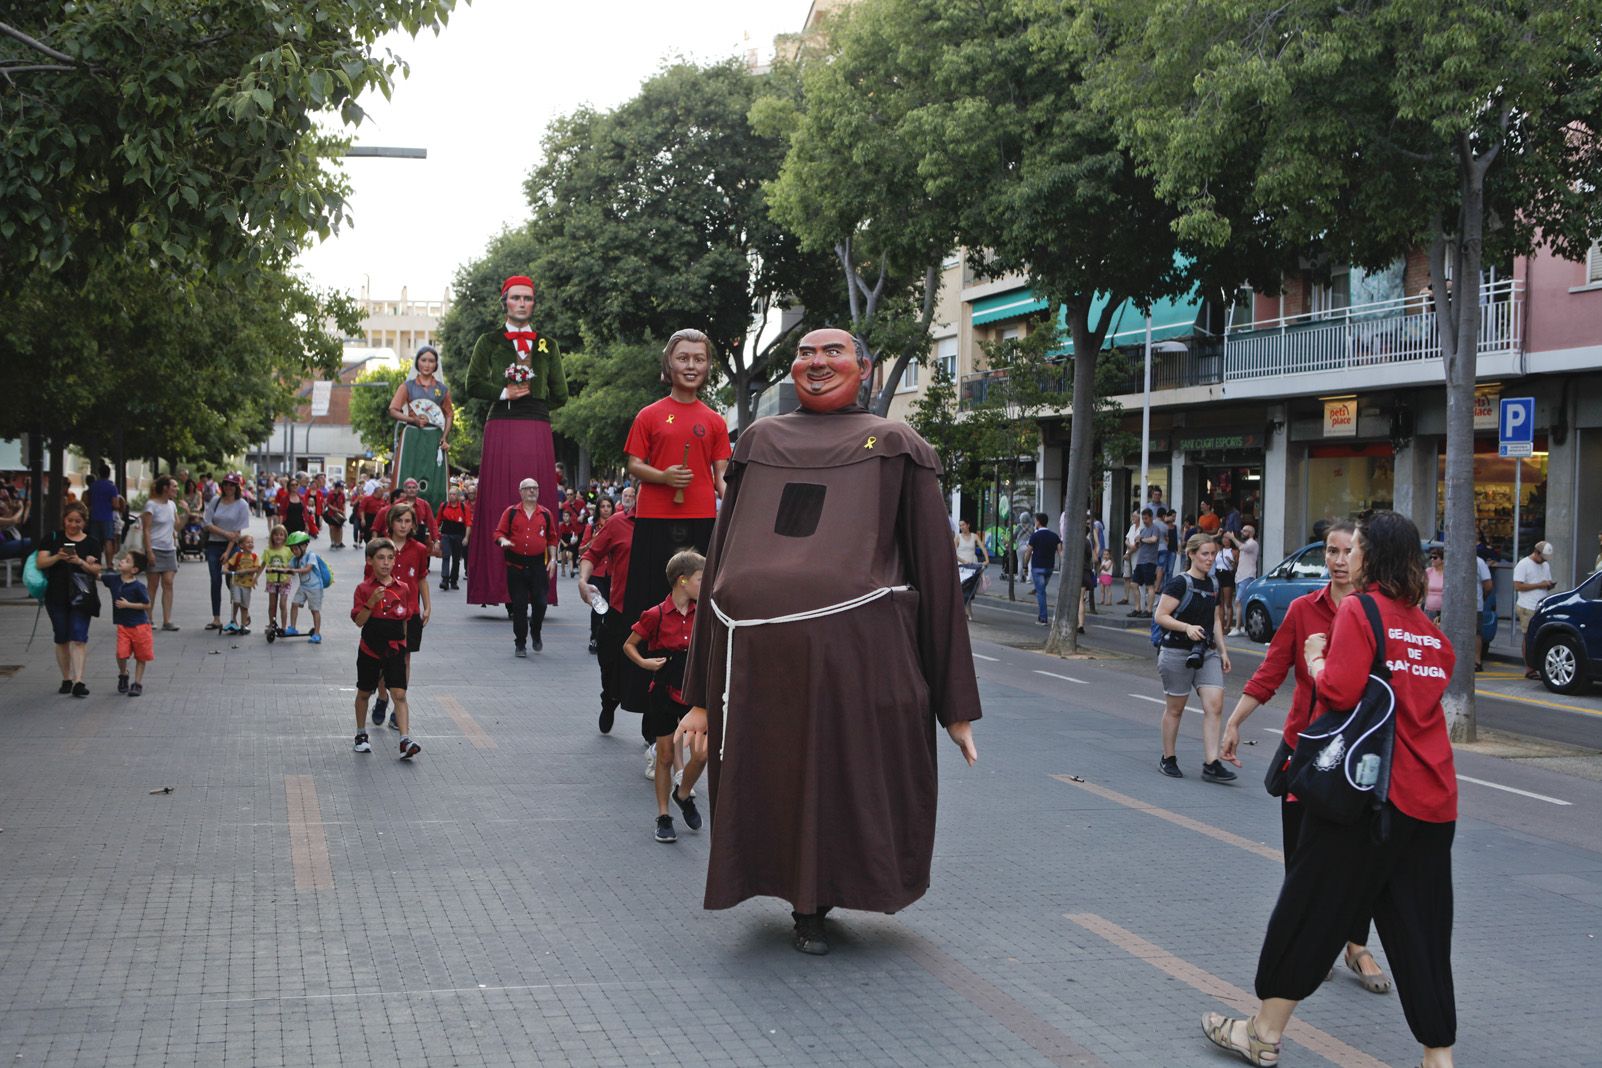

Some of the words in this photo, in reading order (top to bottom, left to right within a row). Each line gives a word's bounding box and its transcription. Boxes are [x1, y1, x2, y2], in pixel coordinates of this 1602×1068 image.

[1330, 407, 1346, 420] pets
[1473, 407, 1492, 417] lace
[1332, 416, 1351, 428] place
[1506, 403, 1525, 438] P
[1216, 436, 1243, 448] ESPORTS
[1407, 648, 1422, 660] DE
[1412, 664, 1446, 679] CUGA
